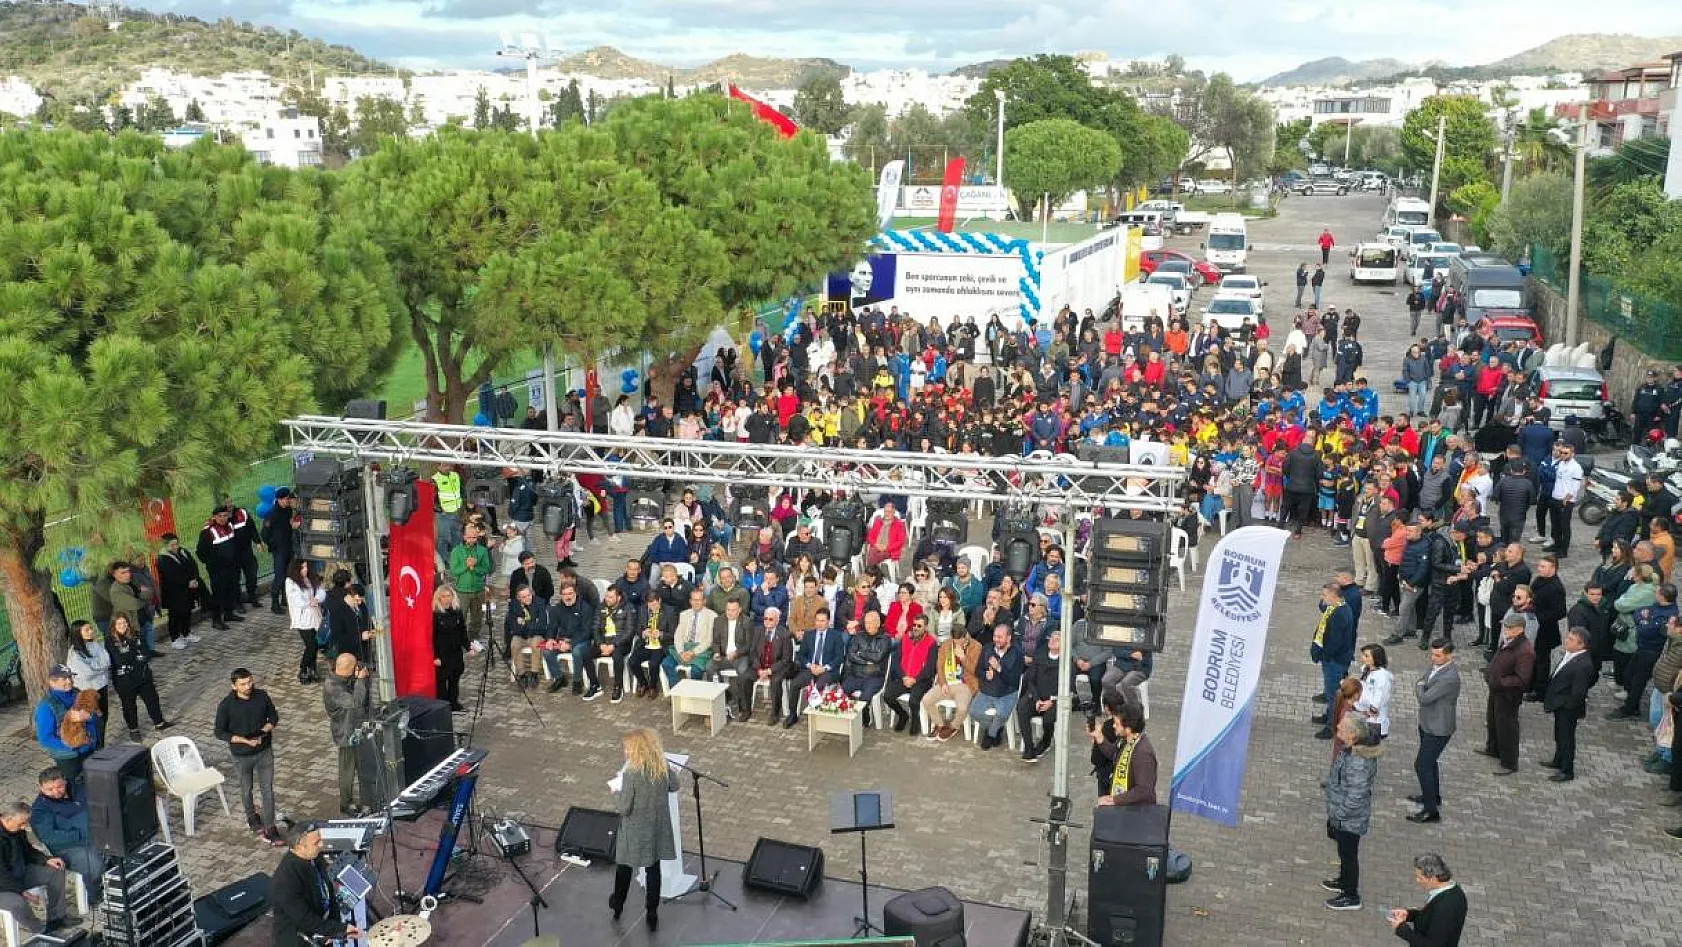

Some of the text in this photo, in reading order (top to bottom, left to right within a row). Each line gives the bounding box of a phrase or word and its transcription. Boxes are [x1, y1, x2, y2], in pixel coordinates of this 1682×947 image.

[905, 271, 919, 280] Ben
[977, 274, 996, 285] çevik
[922, 286, 954, 295] zamanda
[1224, 548, 1266, 568] BODRUM
[1202, 628, 1228, 703] BODRUM
[1220, 634, 1246, 709] BELEDİYESİ
